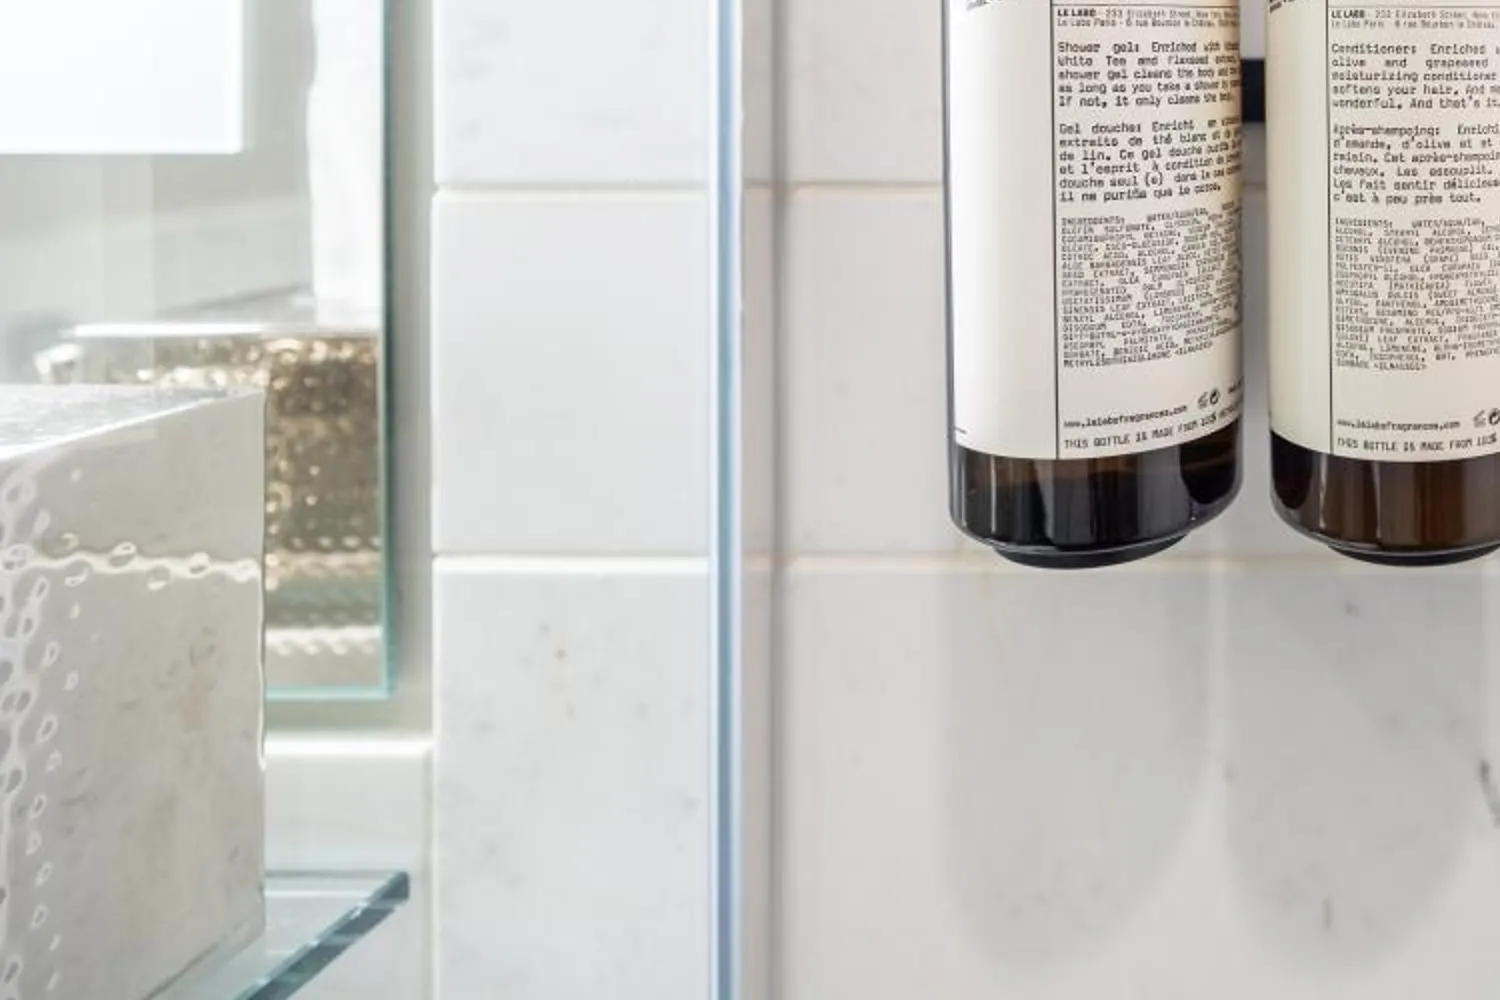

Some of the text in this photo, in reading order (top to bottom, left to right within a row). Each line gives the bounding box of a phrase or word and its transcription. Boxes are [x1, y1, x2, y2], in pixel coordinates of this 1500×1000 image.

[1058, 42, 1100, 52] Shower
[1152, 42, 1196, 52] Enriched
[1431, 44, 1485, 54] Enriched
[1058, 56, 1158, 66] White Tea and
[1332, 58, 1366, 66] olive
[1385, 58, 1407, 67] and
[1058, 70, 1100, 79] shower
[1108, 70, 1128, 80] gel
[1134, 68, 1172, 78] cleans
[1058, 84, 1072, 92] as
[1080, 84, 1107, 94] long
[1132, 84, 1152, 93] you
[1388, 86, 1416, 96] your
[1116, 96, 1128, 106] it
[1136, 96, 1161, 108] only
[1410, 98, 1432, 108] And
[1059, 123, 1080, 134] Gel
[1128, 136, 1142, 145] de
[1059, 151, 1074, 161] de
[1142, 148, 1161, 160] gel
[1059, 165, 1074, 174] et
[1059, 177, 1104, 188] douche
[1359, 178, 1386, 189] fait
[1060, 191, 1074, 201] il
[1082, 193, 1096, 201] ne
[1154, 190, 1172, 199] que
[1064, 439, 1088, 448] THIS
[1364, 437, 1397, 450] BOTTLE
